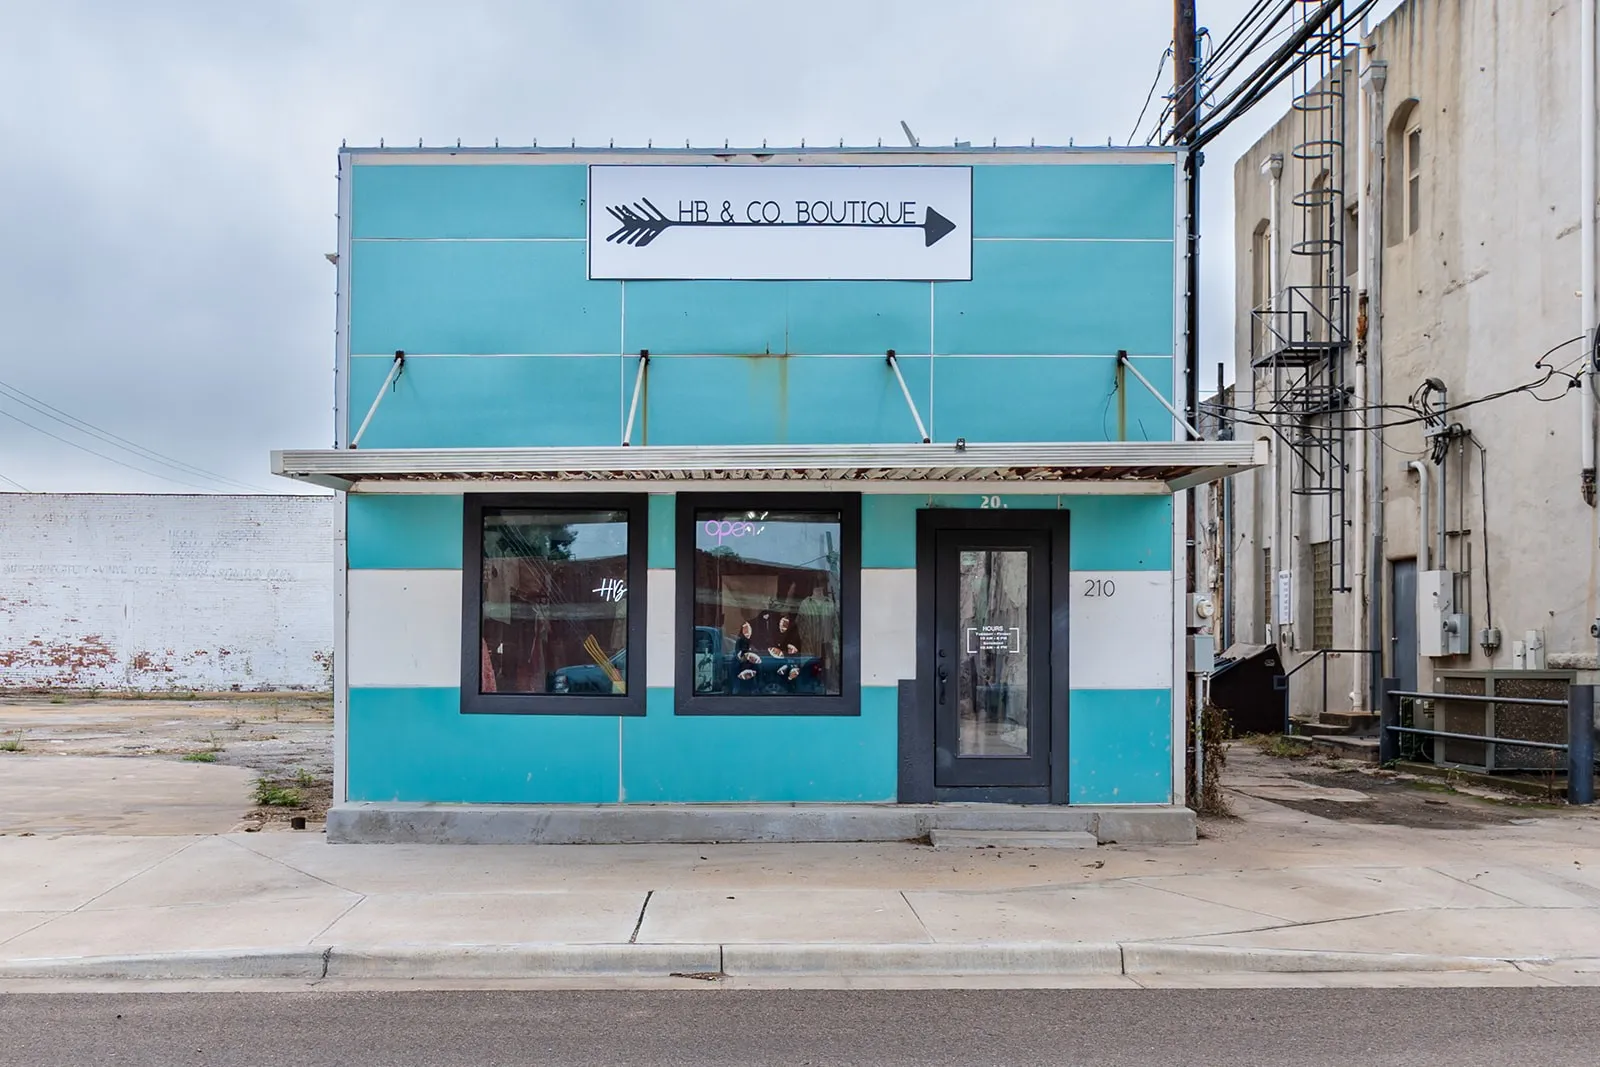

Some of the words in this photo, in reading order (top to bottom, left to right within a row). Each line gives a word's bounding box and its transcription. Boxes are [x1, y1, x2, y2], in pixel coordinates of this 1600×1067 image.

[679, 200, 708, 223] HB
[720, 200, 735, 223] &
[746, 200, 784, 223] CO.
[795, 200, 916, 223] BOUTIQUE
[1084, 579, 1116, 598] 210
